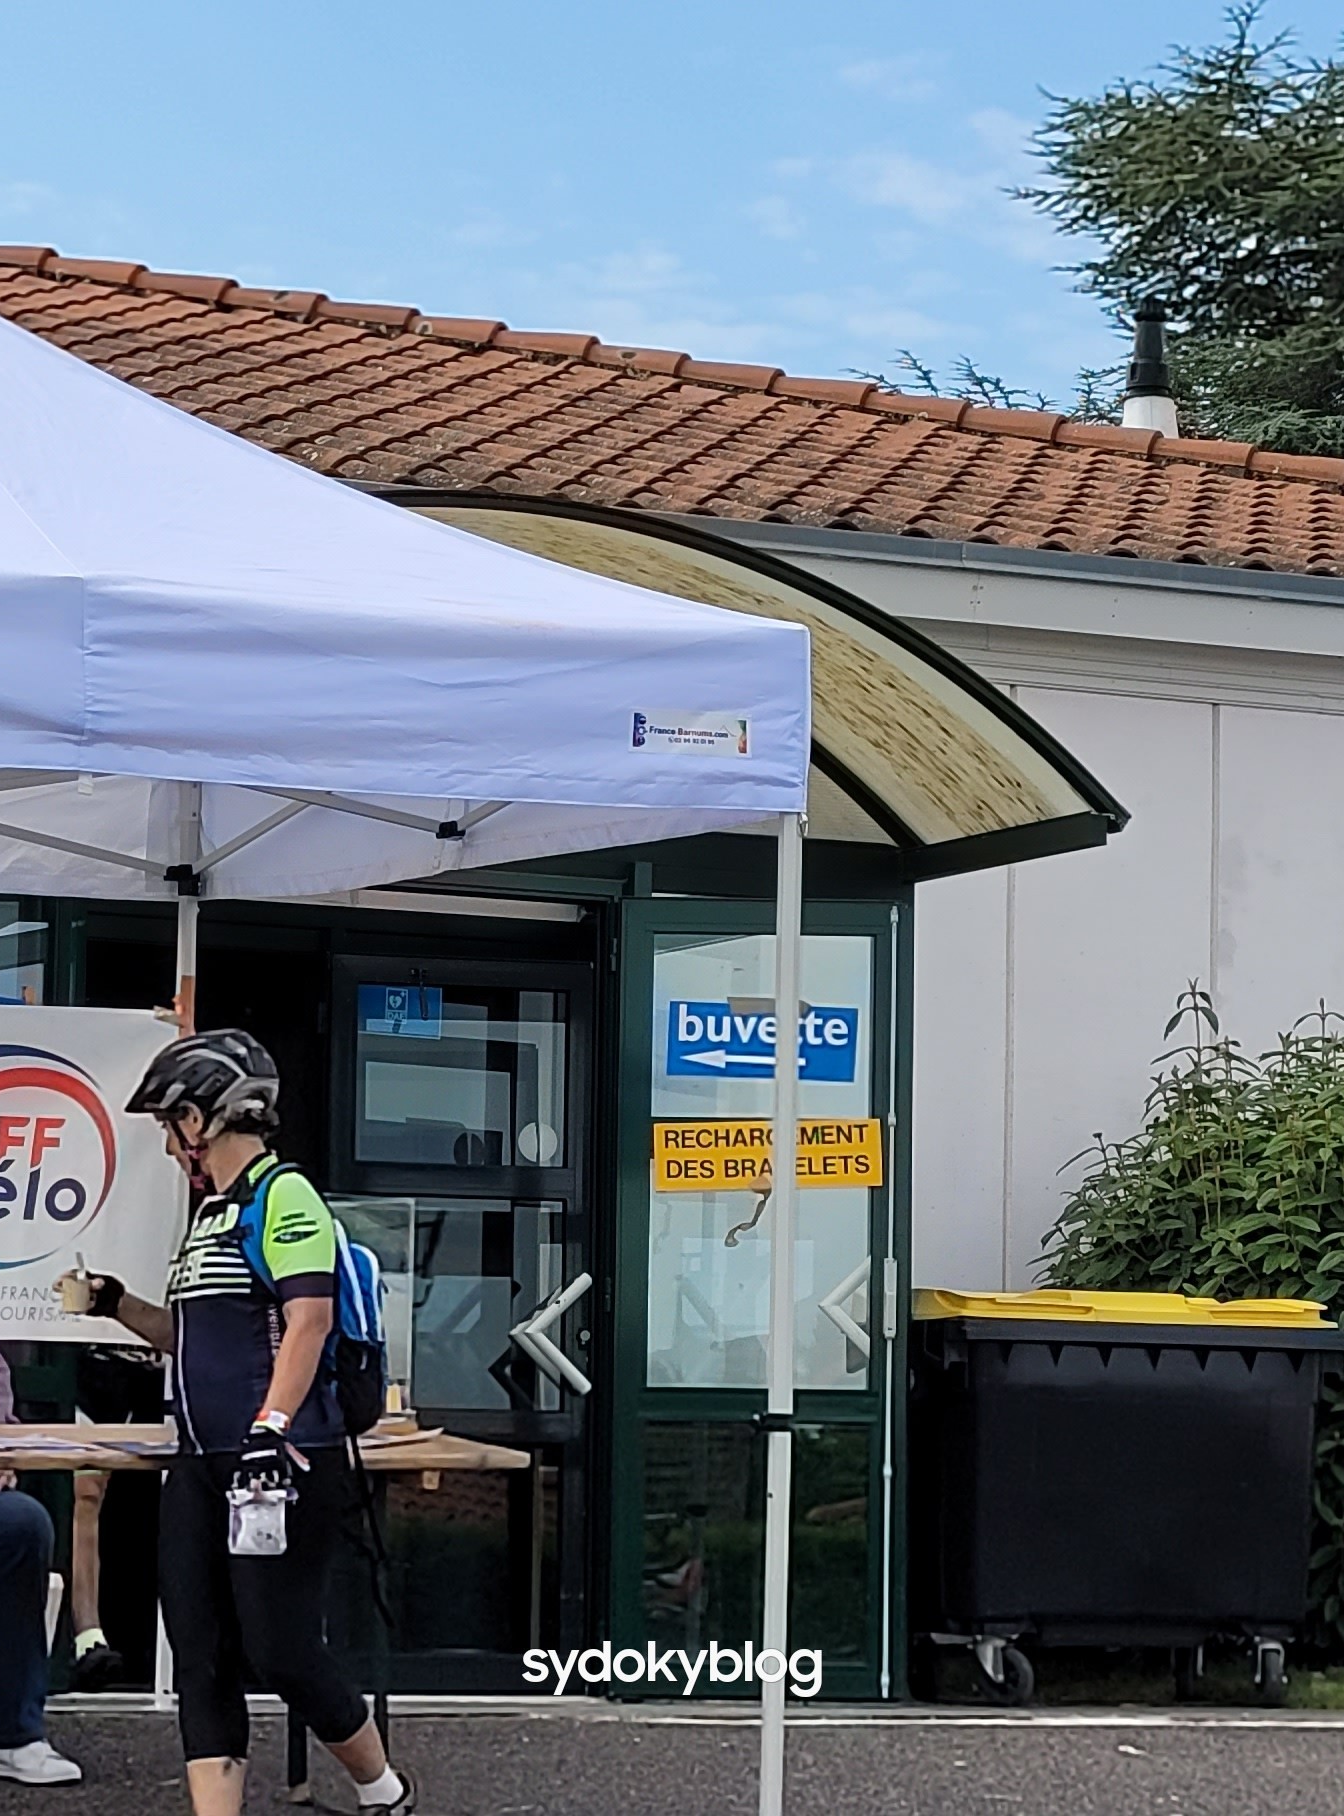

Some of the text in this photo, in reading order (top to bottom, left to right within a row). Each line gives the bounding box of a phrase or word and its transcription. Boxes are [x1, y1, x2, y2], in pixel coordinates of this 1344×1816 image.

[649, 726, 676, 735] France
[677, 1003, 849, 1046] buvete
[664, 1124, 869, 1149] RECHARMENT
[666, 1155, 870, 1179] DES BRAELETS
[1, 1286, 54, 1302] FRAN
